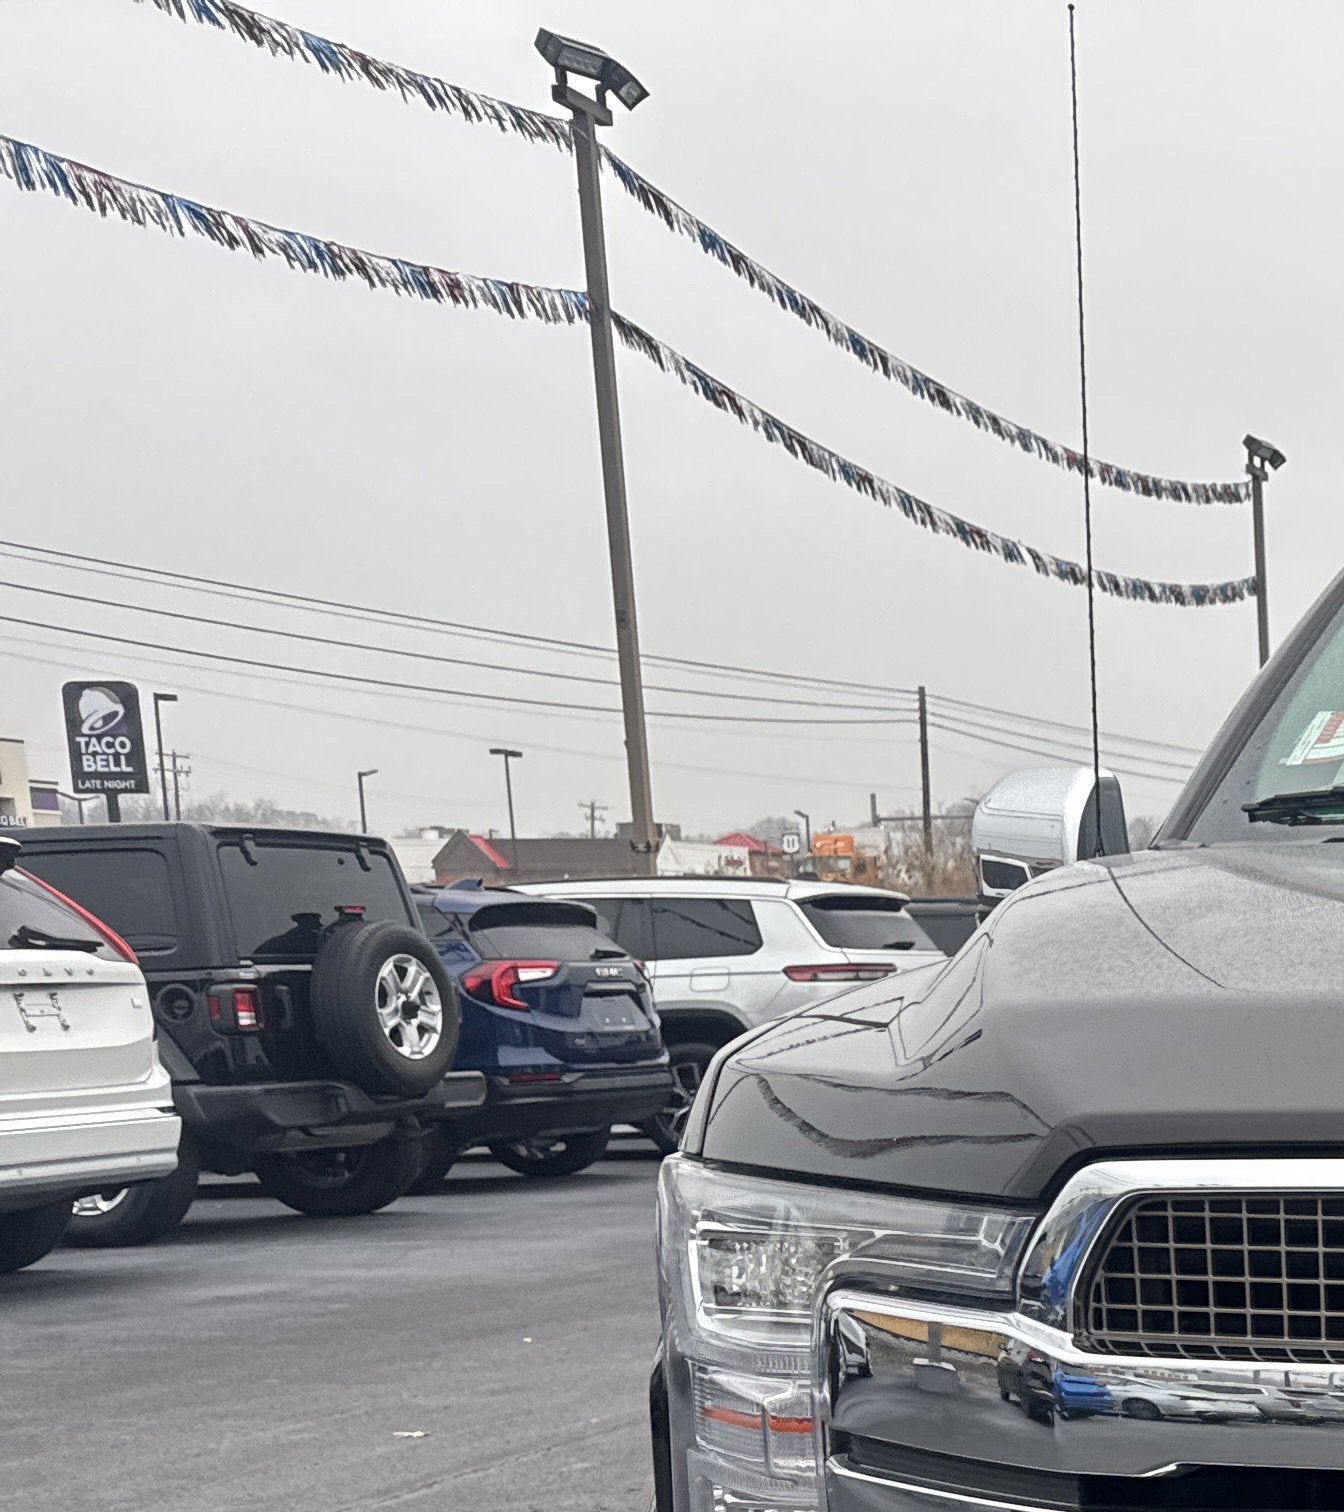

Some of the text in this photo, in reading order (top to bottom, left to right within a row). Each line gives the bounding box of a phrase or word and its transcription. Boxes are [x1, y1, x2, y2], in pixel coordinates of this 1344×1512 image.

[75, 736, 132, 754] TACO
[82, 754, 134, 772] BELL
[78, 780, 136, 789] LATE NIGHT
[787, 837, 795, 848] 11
